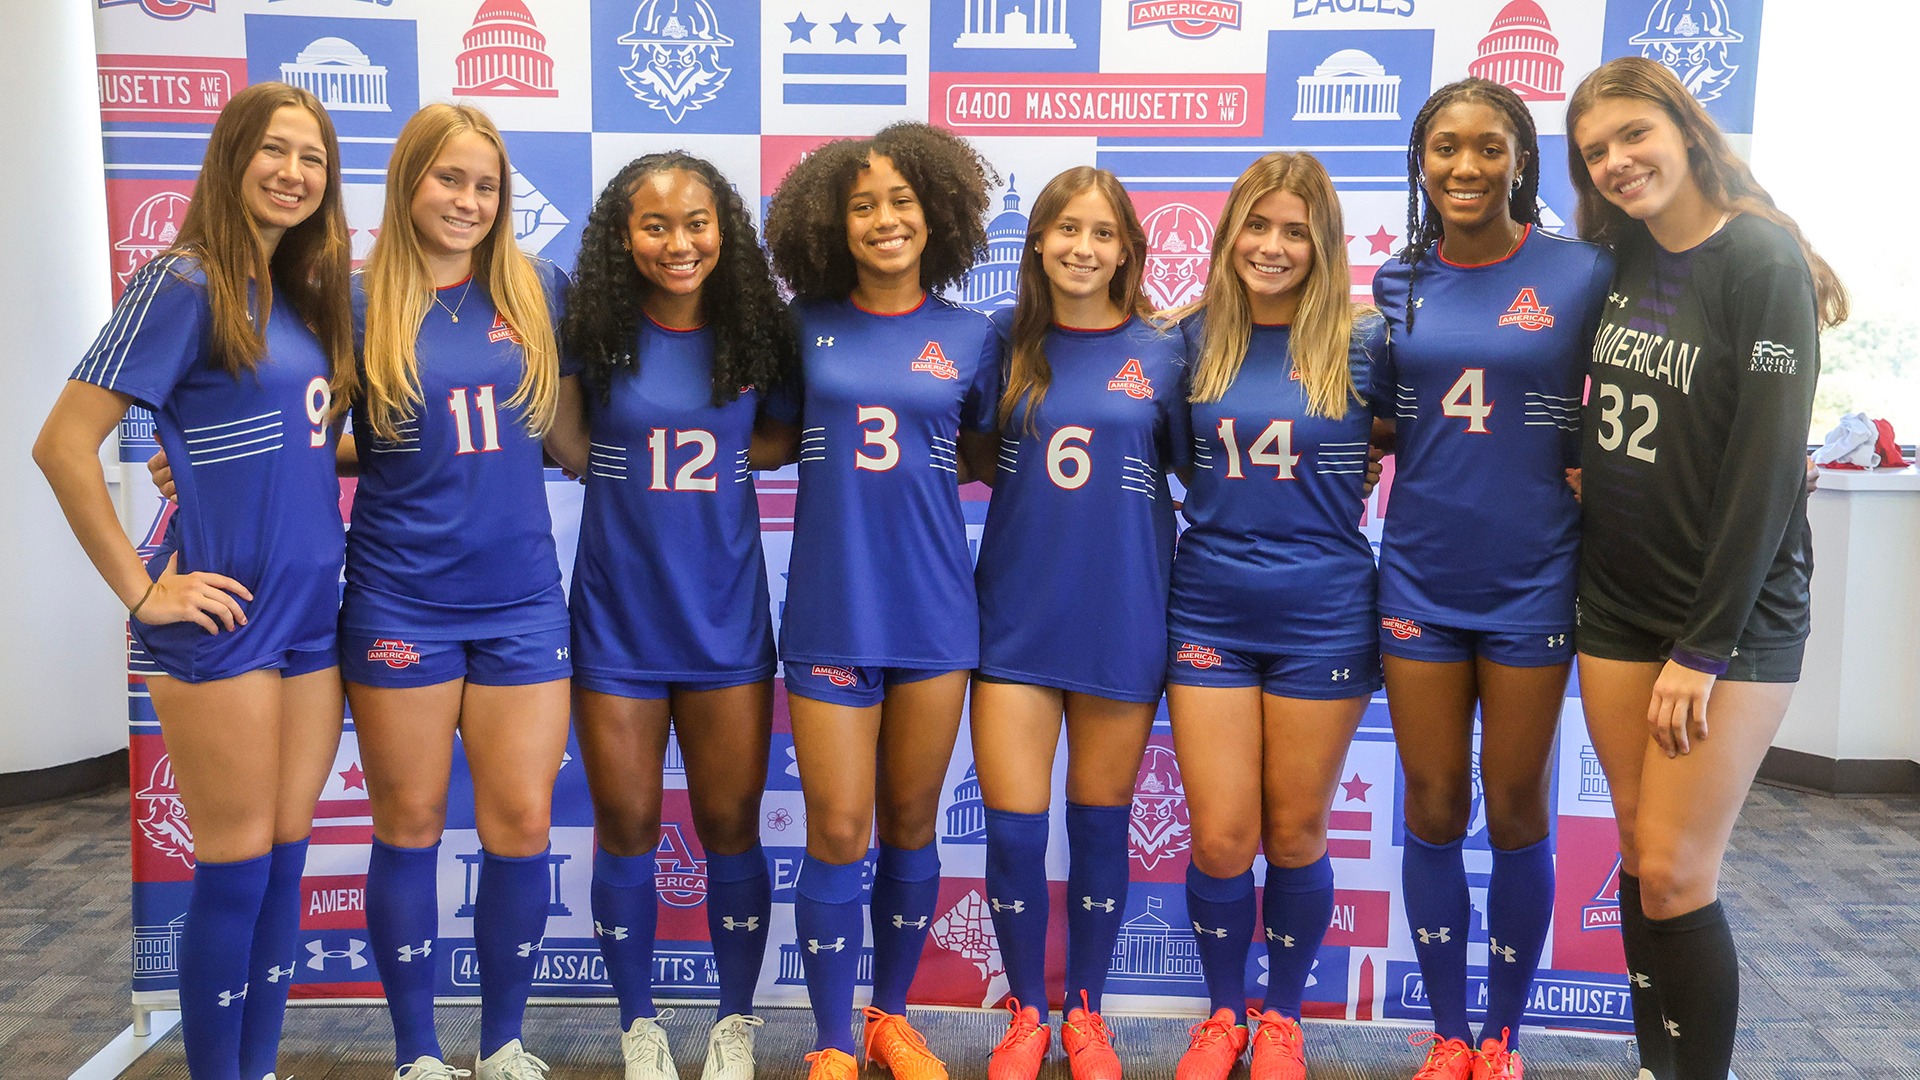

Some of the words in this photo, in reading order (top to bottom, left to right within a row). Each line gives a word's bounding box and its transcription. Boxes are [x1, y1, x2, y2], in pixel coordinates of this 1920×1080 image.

[1137, 3, 1234, 20] AMERICAN
[200, 77, 221, 92] AVE
[204, 92, 219, 107] NW
[955, 92, 1011, 120] 4400
[1025, 92, 1209, 120] MASSACHUSETTS
[1217, 92, 1239, 107] AVE
[1220, 107, 1235, 121] NW
[1502, 314, 1551, 324] AMERICAN
[914, 363, 957, 376] AMERICAN
[1748, 363, 1796, 375] EAGUE
[1110, 382, 1152, 396] AMERICAN
[1440, 368, 1495, 434] 4
[306, 376, 331, 448] 9
[448, 384, 503, 455] 11
[1598, 383, 1659, 464] 32
[854, 404, 900, 472] 3
[1216, 417, 1302, 480] 14
[648, 427, 718, 492] 12
[1046, 424, 1095, 490] 6
[1383, 620, 1419, 634] AMERICAN
[370, 652, 418, 661] AMERICAN
[1179, 653, 1219, 663] AMERICAN
[815, 666, 856, 682] AMERICAN
[1589, 910, 1621, 923] AM
